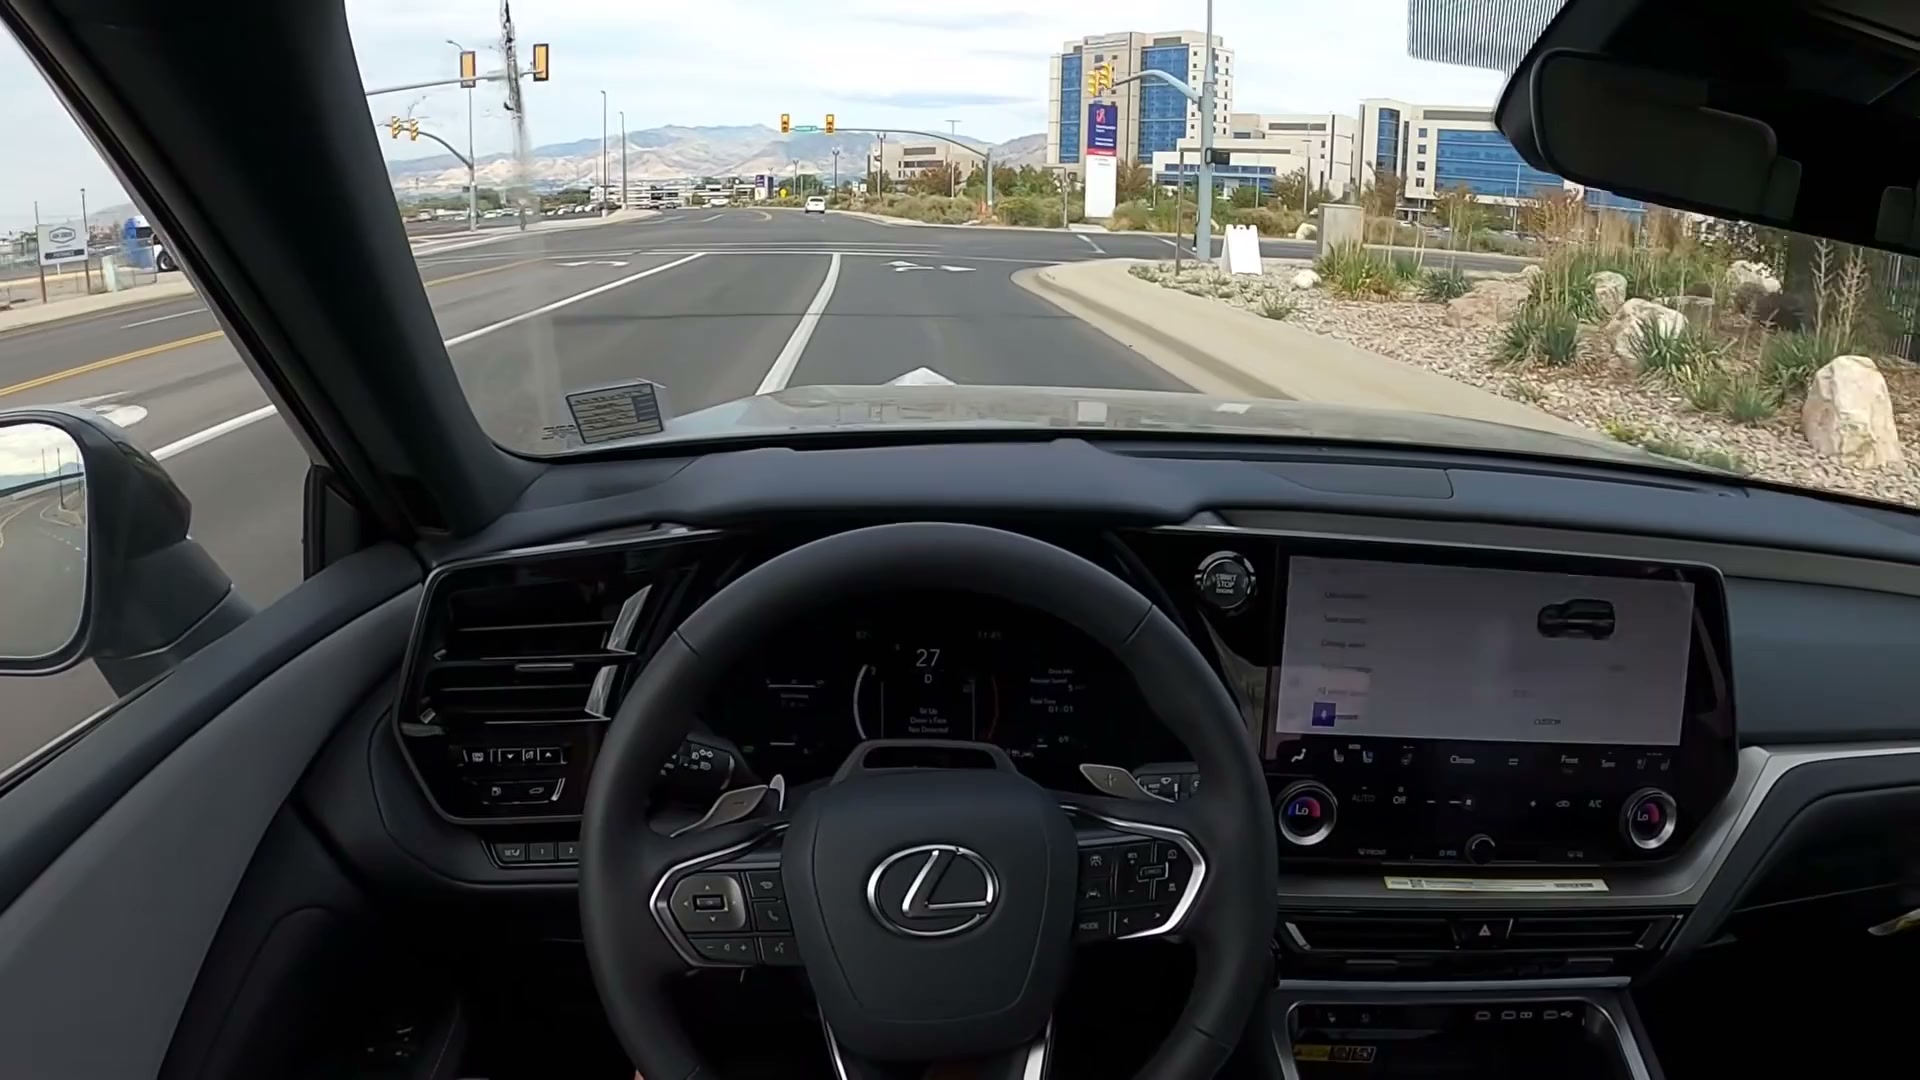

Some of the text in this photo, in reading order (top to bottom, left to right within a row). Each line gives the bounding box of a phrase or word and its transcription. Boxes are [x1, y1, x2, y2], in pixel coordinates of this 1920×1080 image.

[1217, 580, 1235, 588] STOP
[915, 648, 941, 667] 27
[924, 674, 933, 684] D
[1352, 793, 1376, 803] AUTO
[1393, 795, 1407, 805] Off
[1588, 799, 1603, 808] A/C
[1294, 803, 1309, 817] Lo
[1637, 810, 1649, 821] Lo
